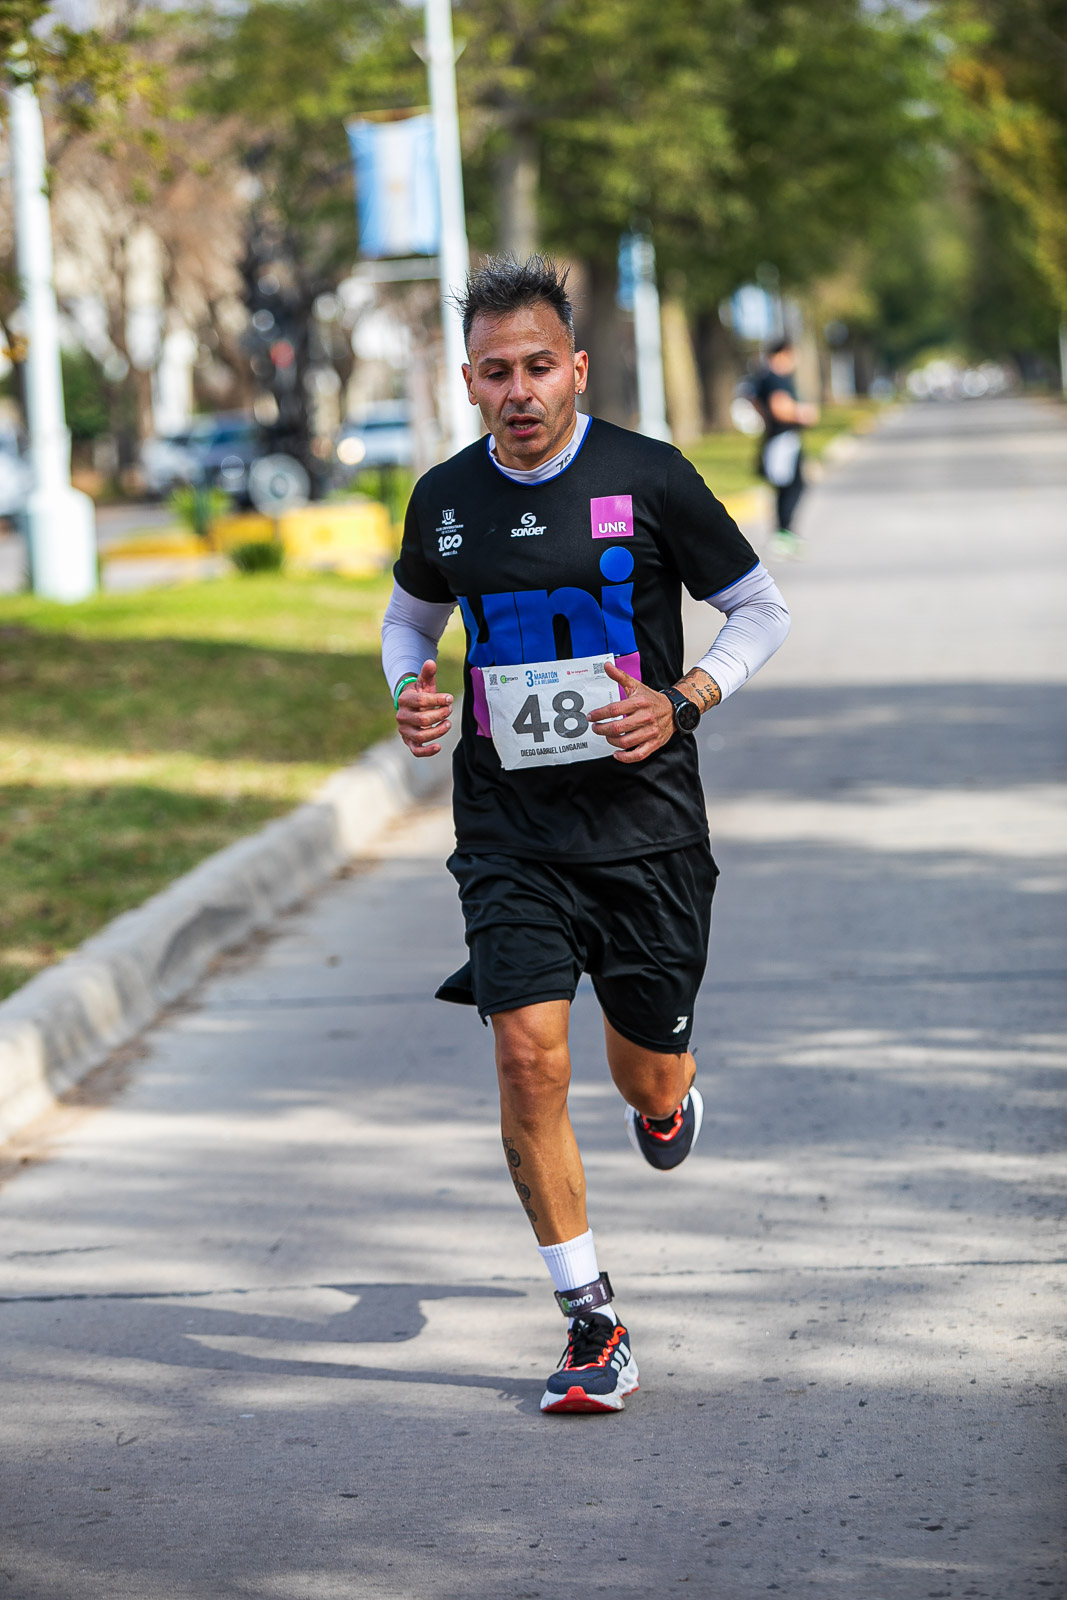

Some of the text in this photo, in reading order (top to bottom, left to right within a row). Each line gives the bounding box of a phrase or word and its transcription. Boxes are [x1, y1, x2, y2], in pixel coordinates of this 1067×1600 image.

[599, 521, 627, 534] UNR
[438, 534, 463, 552] 100
[525, 670, 534, 687] 3
[512, 690, 589, 743] 48
[520, 741, 589, 757] DIEGO GABRIEL LONGARINI
